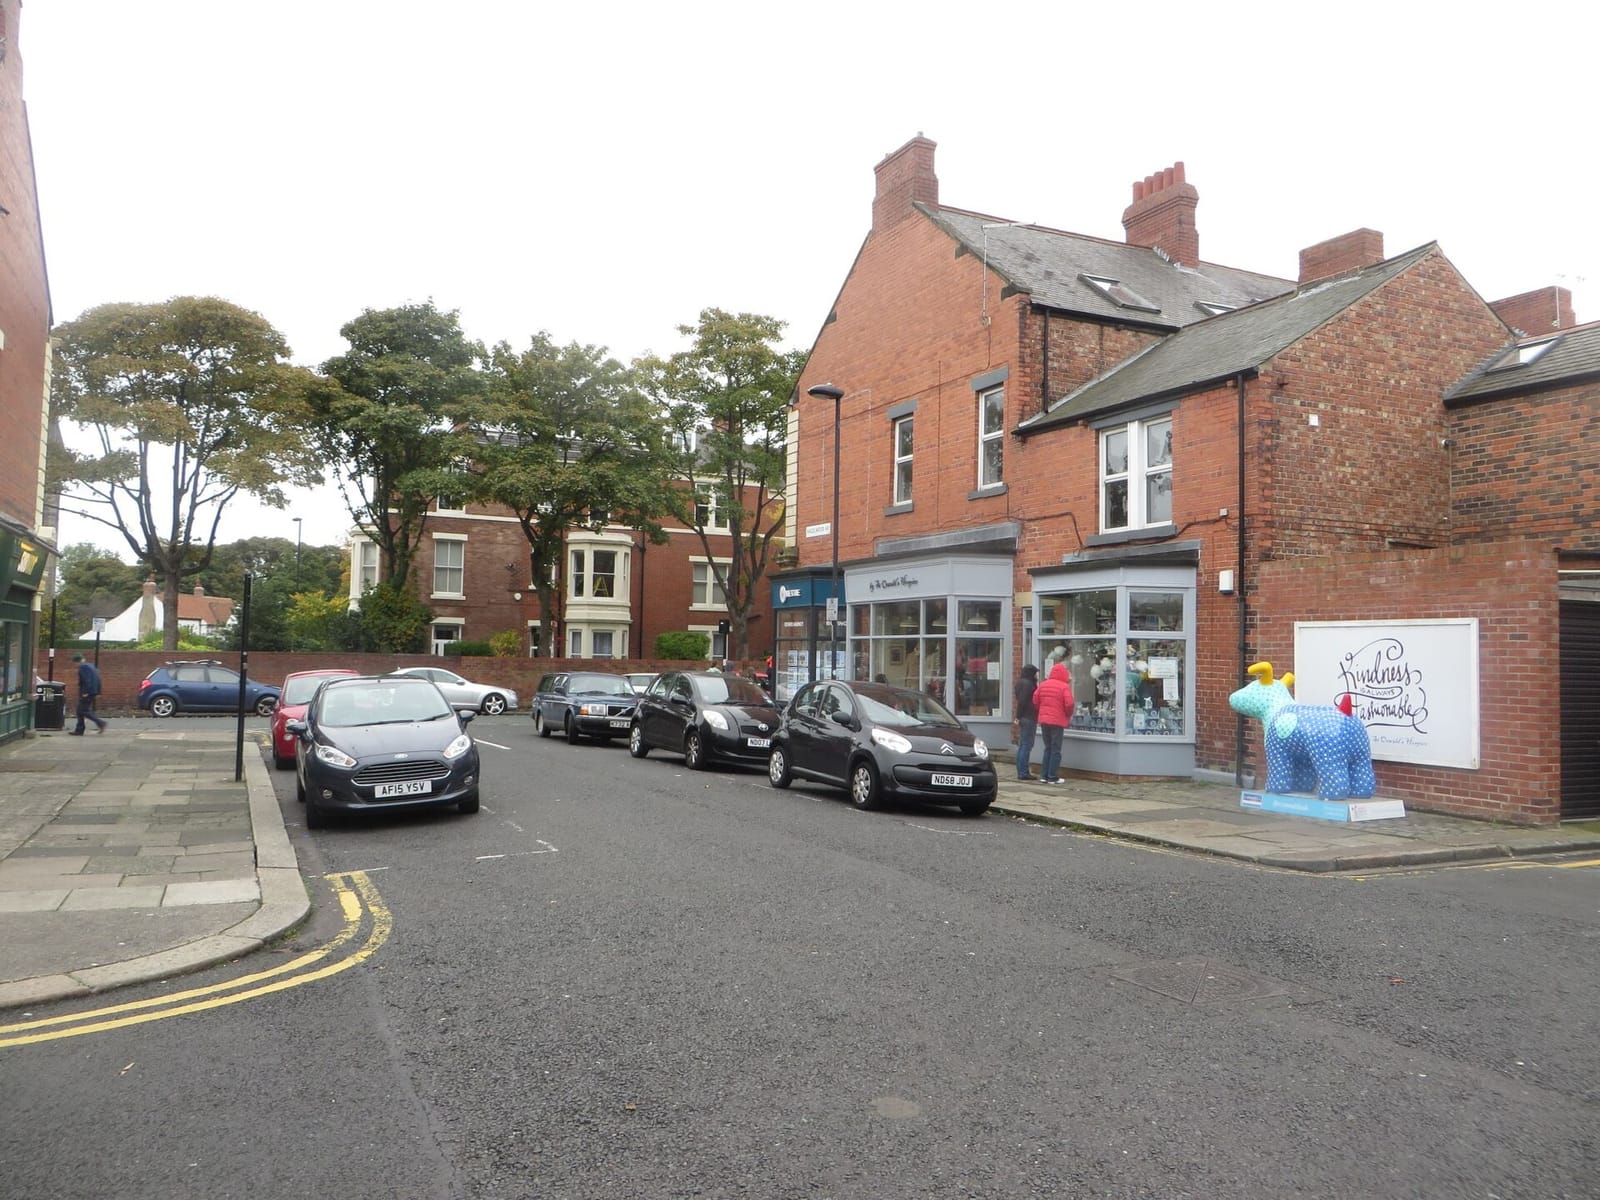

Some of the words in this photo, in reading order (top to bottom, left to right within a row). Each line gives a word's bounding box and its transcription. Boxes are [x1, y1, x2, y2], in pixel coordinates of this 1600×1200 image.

[1338, 649, 1413, 690] Kindness
[1367, 688, 1396, 696] ALWAYS
[934, 775, 955, 785] ND58
[381, 784, 404, 796] AF15
[406, 782, 425, 793] YSV
